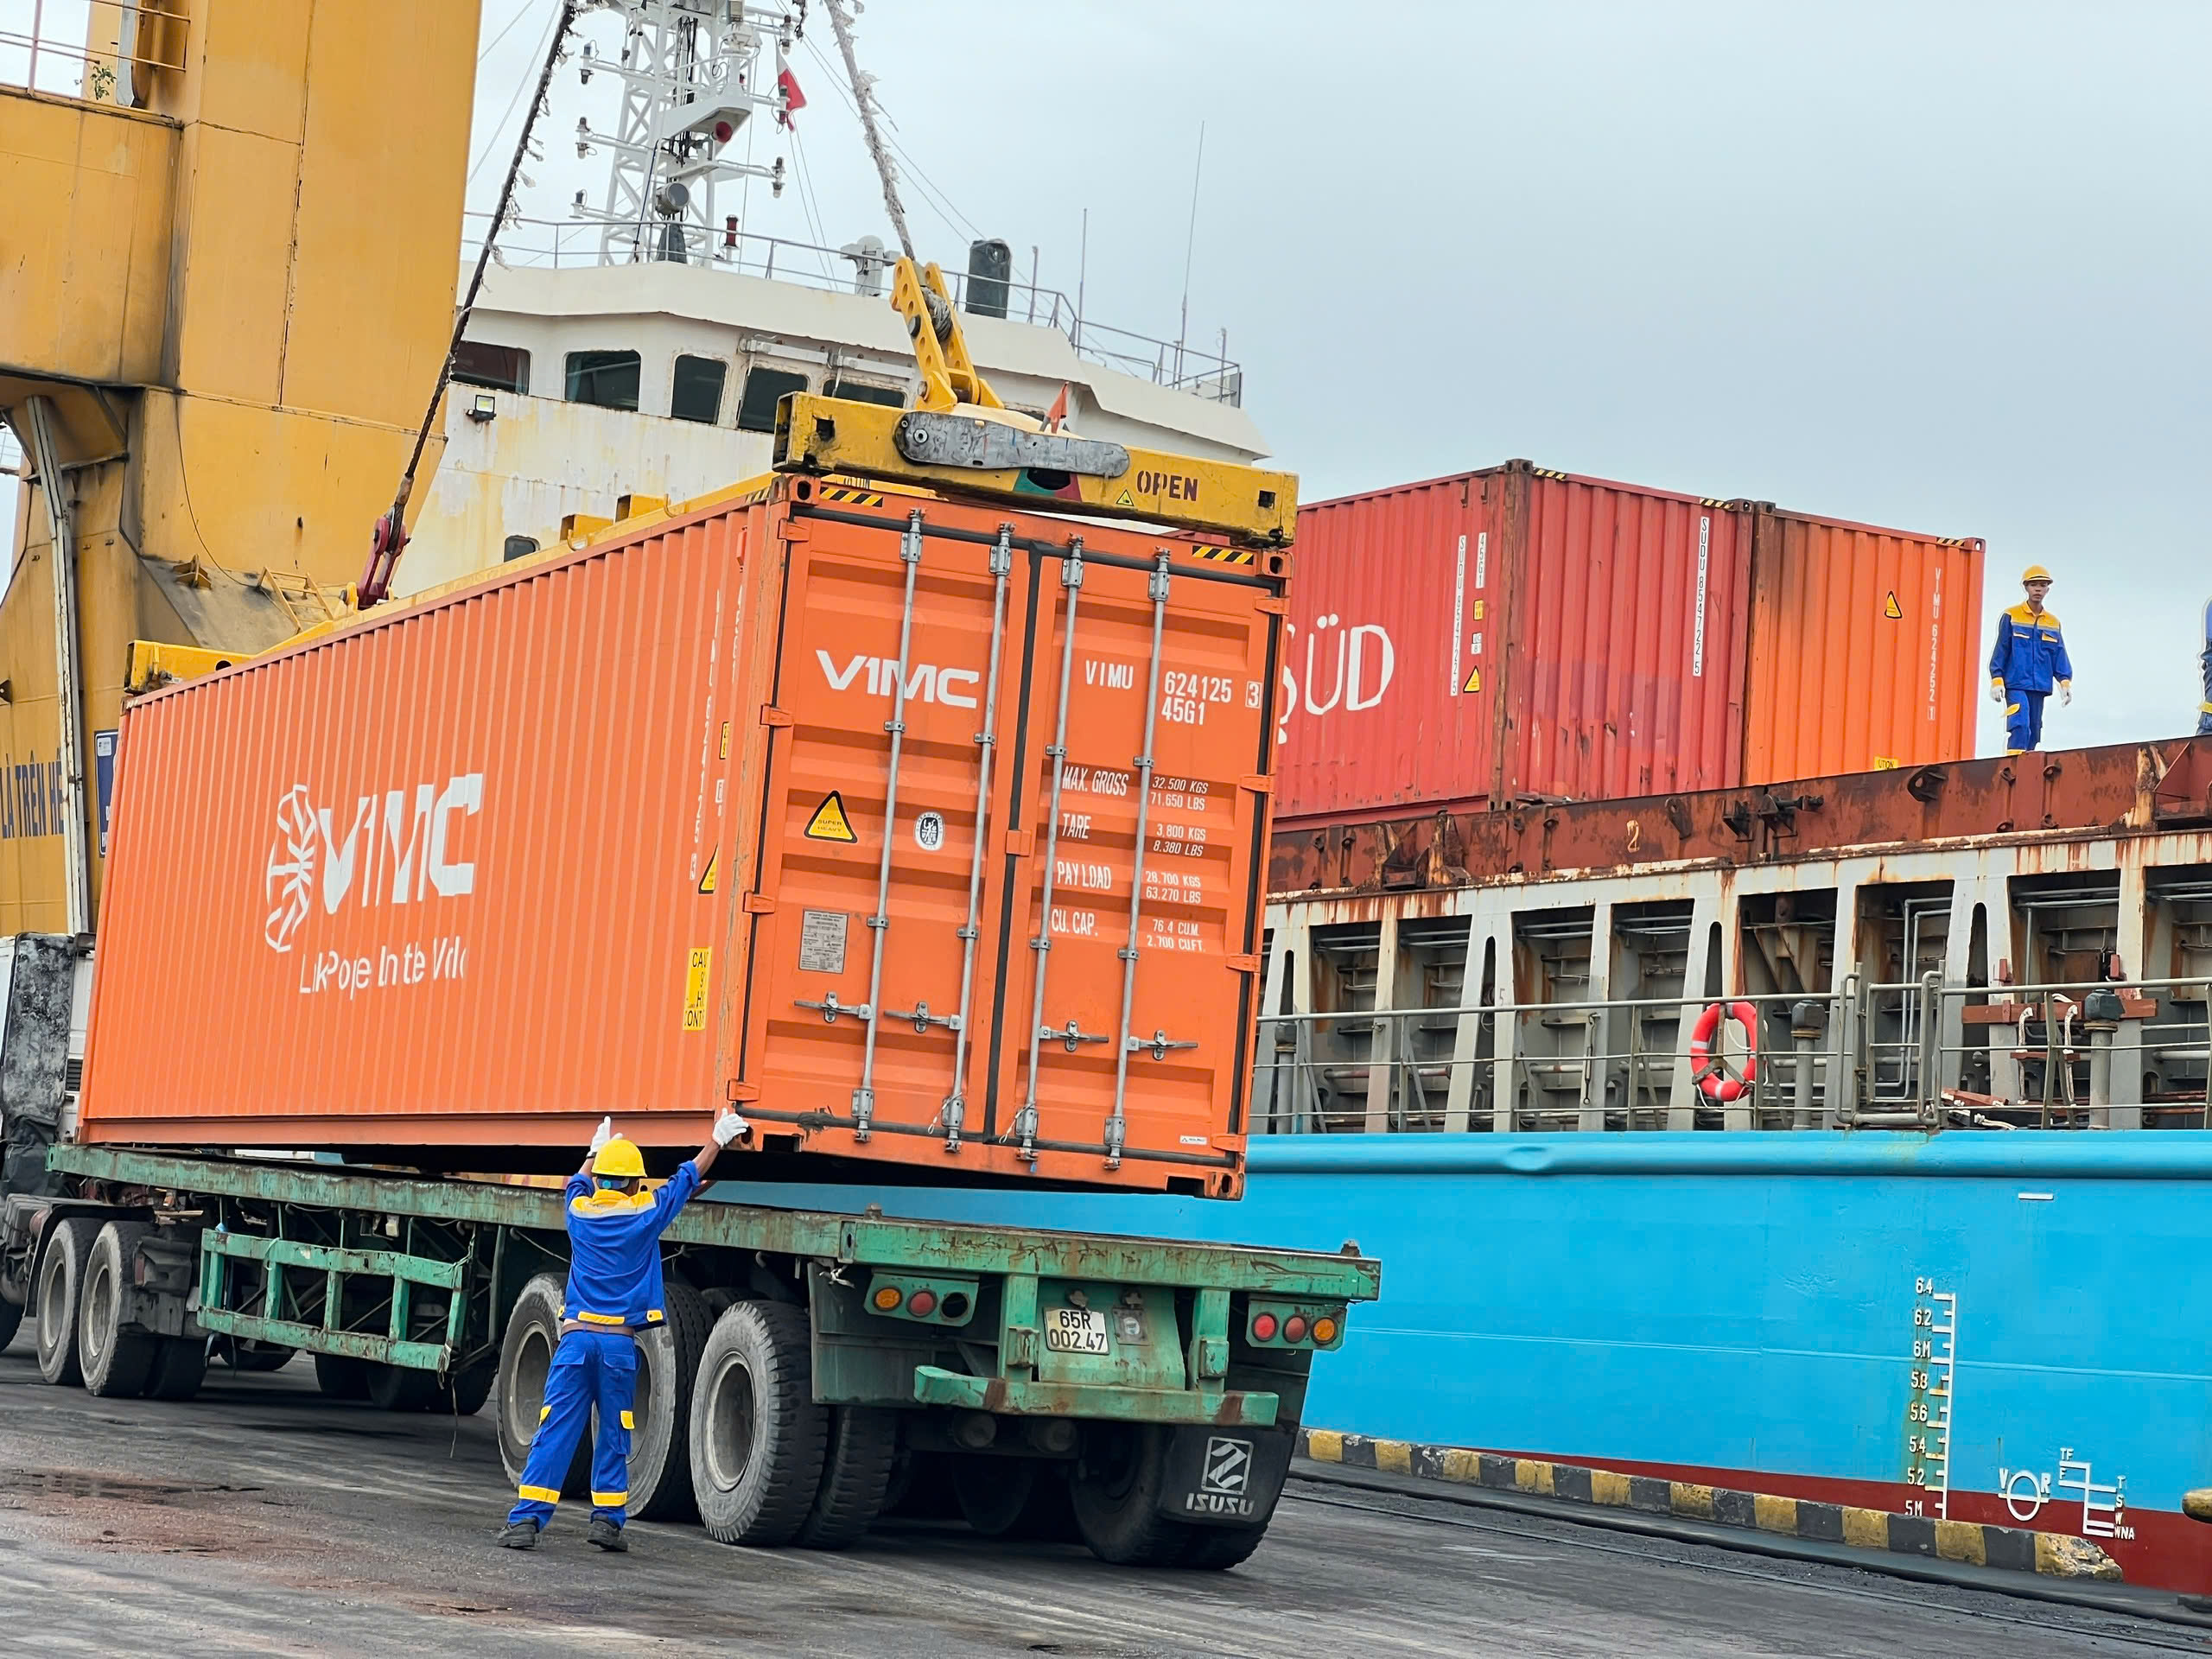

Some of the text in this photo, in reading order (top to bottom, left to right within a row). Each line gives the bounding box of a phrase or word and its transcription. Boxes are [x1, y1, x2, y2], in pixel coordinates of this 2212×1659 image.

[1137, 470, 1198, 501] OPEN
[1694, 661, 1700, 674] 5
[1929, 624, 1938, 702] 624252
[816, 650, 979, 709] VIMC
[1085, 660, 1261, 708] VIMU 624125 3
[1452, 681, 1457, 694] 5
[1161, 696, 1205, 725] 45G1
[1062, 766, 1209, 796] MAX. GROSS 32.500 KGS
[15, 749, 47, 837] TRÊN
[1150, 791, 1205, 810] 71.650 LBS
[1062, 813, 1091, 839] TARE
[1188, 827, 1206, 842] KGS
[1626, 819, 1640, 854] 2
[318, 773, 483, 915] VIMC
[1154, 840, 1204, 857] 8.380 LBS
[1146, 871, 1179, 885] 28.700
[1182, 874, 1201, 887] KGS
[1146, 887, 1201, 904] 63.270 LBS
[1051, 908, 1070, 933] CU.
[1072, 911, 1098, 937] CAP.
[1153, 918, 1173, 933] 76.4
[1147, 935, 1174, 949] 2.700
[1916, 1276, 1933, 1294] 6.4
[1059, 1310, 1091, 1330] 65R
[1914, 1308, 1932, 1326] 6.2
[1049, 1329, 1105, 1351] 002.47
[1910, 1370, 1928, 1389] 5.8
[1910, 1402, 1928, 1421] 5.6
[1909, 1435, 1926, 1454] 5.4
[2060, 1447, 2074, 1460] TF
[1907, 1466, 1924, 1485] 5.2
[2040, 1472, 2051, 1494] R
[2059, 1468, 2067, 1480] F
[2117, 1475, 2126, 1490] T
[2115, 1494, 2124, 1509] S
[2113, 1526, 2135, 1541] WNA
